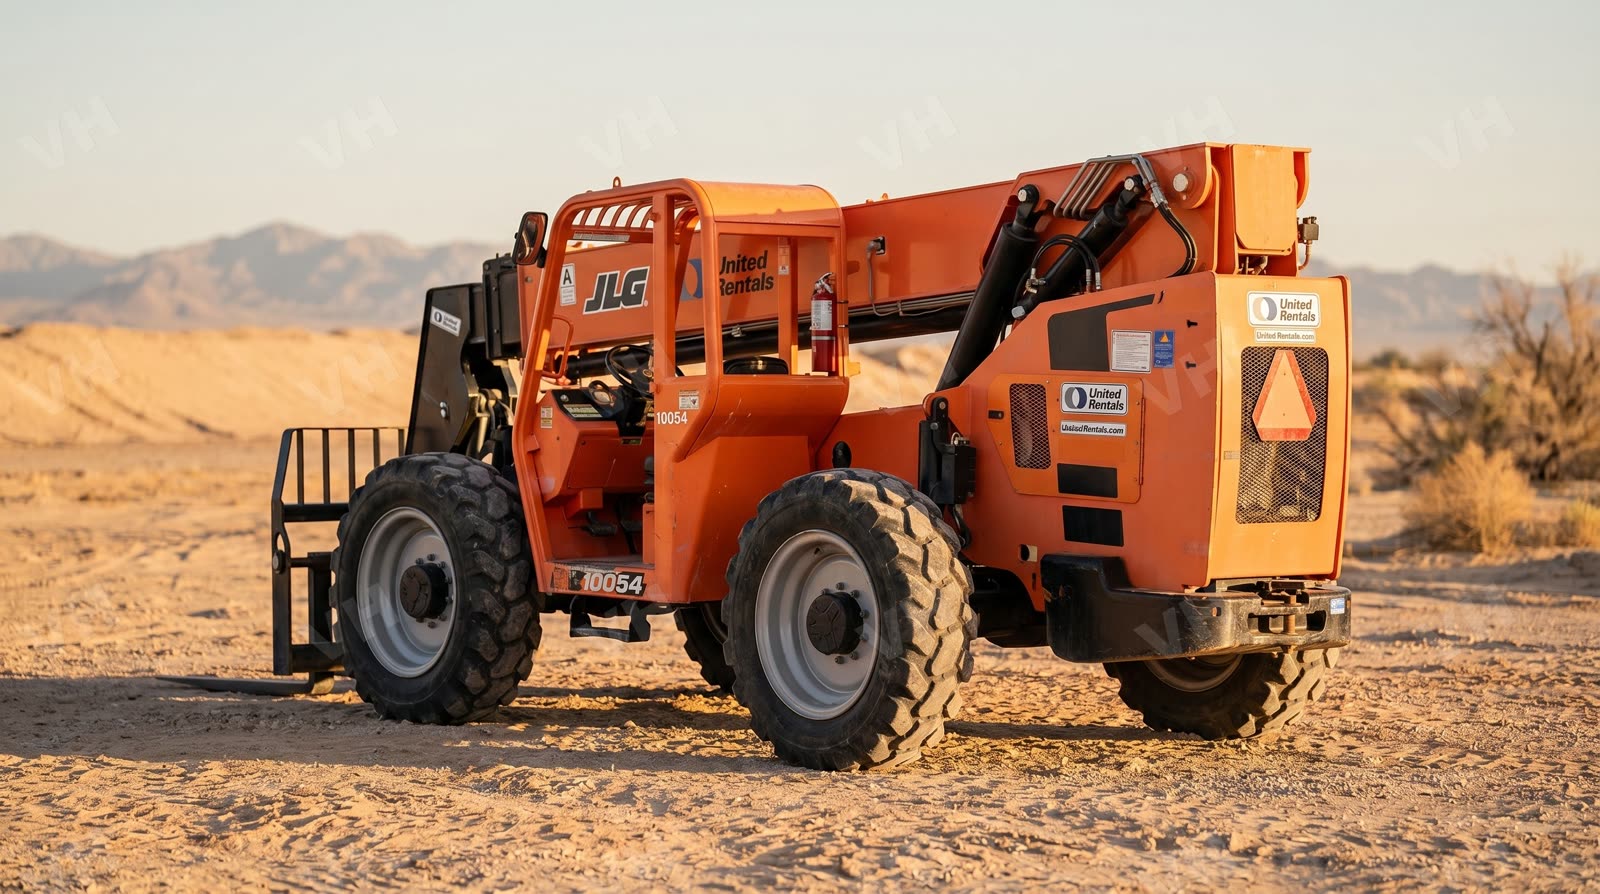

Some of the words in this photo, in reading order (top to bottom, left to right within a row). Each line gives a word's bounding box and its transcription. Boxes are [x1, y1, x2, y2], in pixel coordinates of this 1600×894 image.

[562, 268, 573, 286] A
[583, 266, 650, 315] JLG
[1280, 298, 1313, 310] United
[1280, 310, 1316, 322] Rentals
[1089, 387, 1122, 399] United
[1088, 399, 1124, 411] Rentals
[656, 411, 688, 425] 10054
[583, 572, 643, 595] 10054
